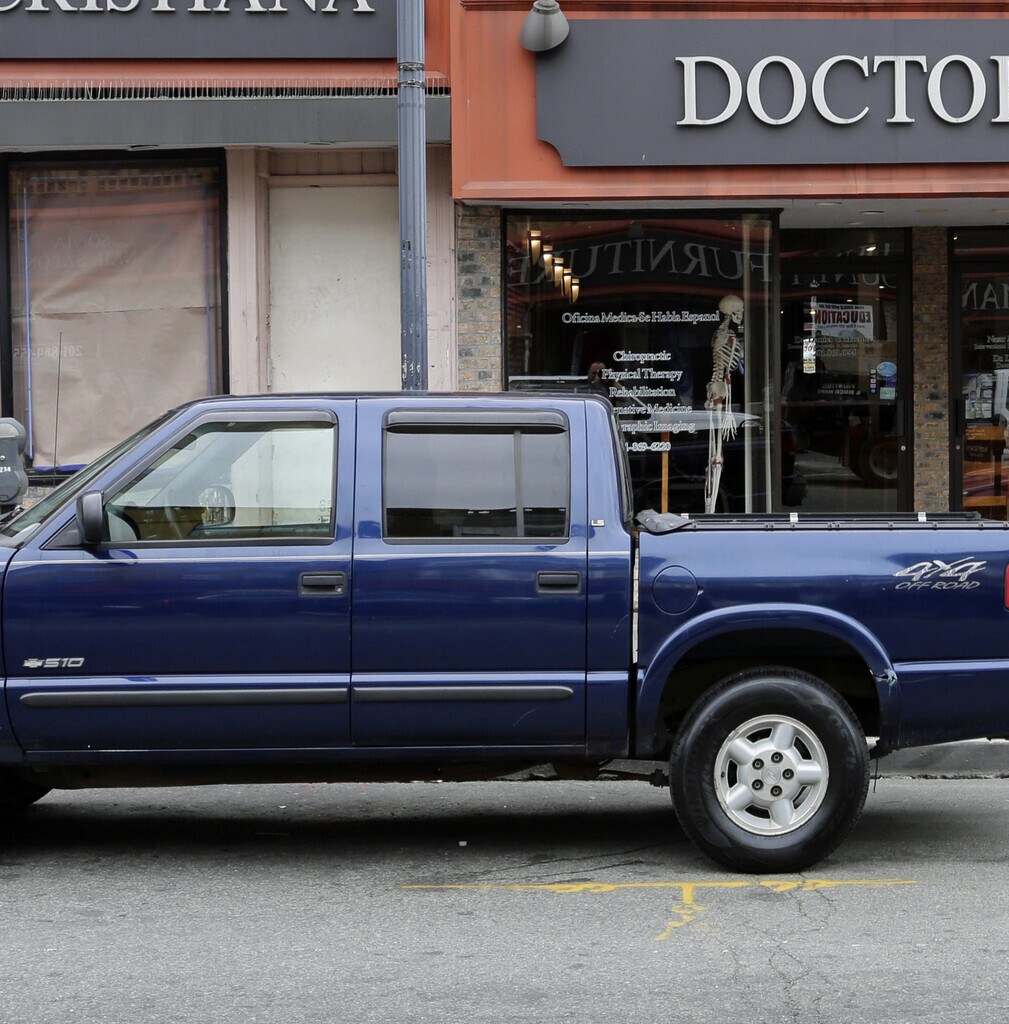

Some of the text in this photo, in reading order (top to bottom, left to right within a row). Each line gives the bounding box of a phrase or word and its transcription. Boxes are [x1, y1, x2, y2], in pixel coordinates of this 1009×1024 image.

[562, 311, 600, 323] Oficina
[651, 310, 682, 323] Habla
[612, 350, 672, 363] Chiropractic
[601, 367, 683, 382] Physical Therapy
[608, 386, 676, 397] Rehabilitation
[646, 403, 693, 414] Medicine
[895, 581, 981, 590] OFF ROAD
[43, 657, 85, 668] S10
